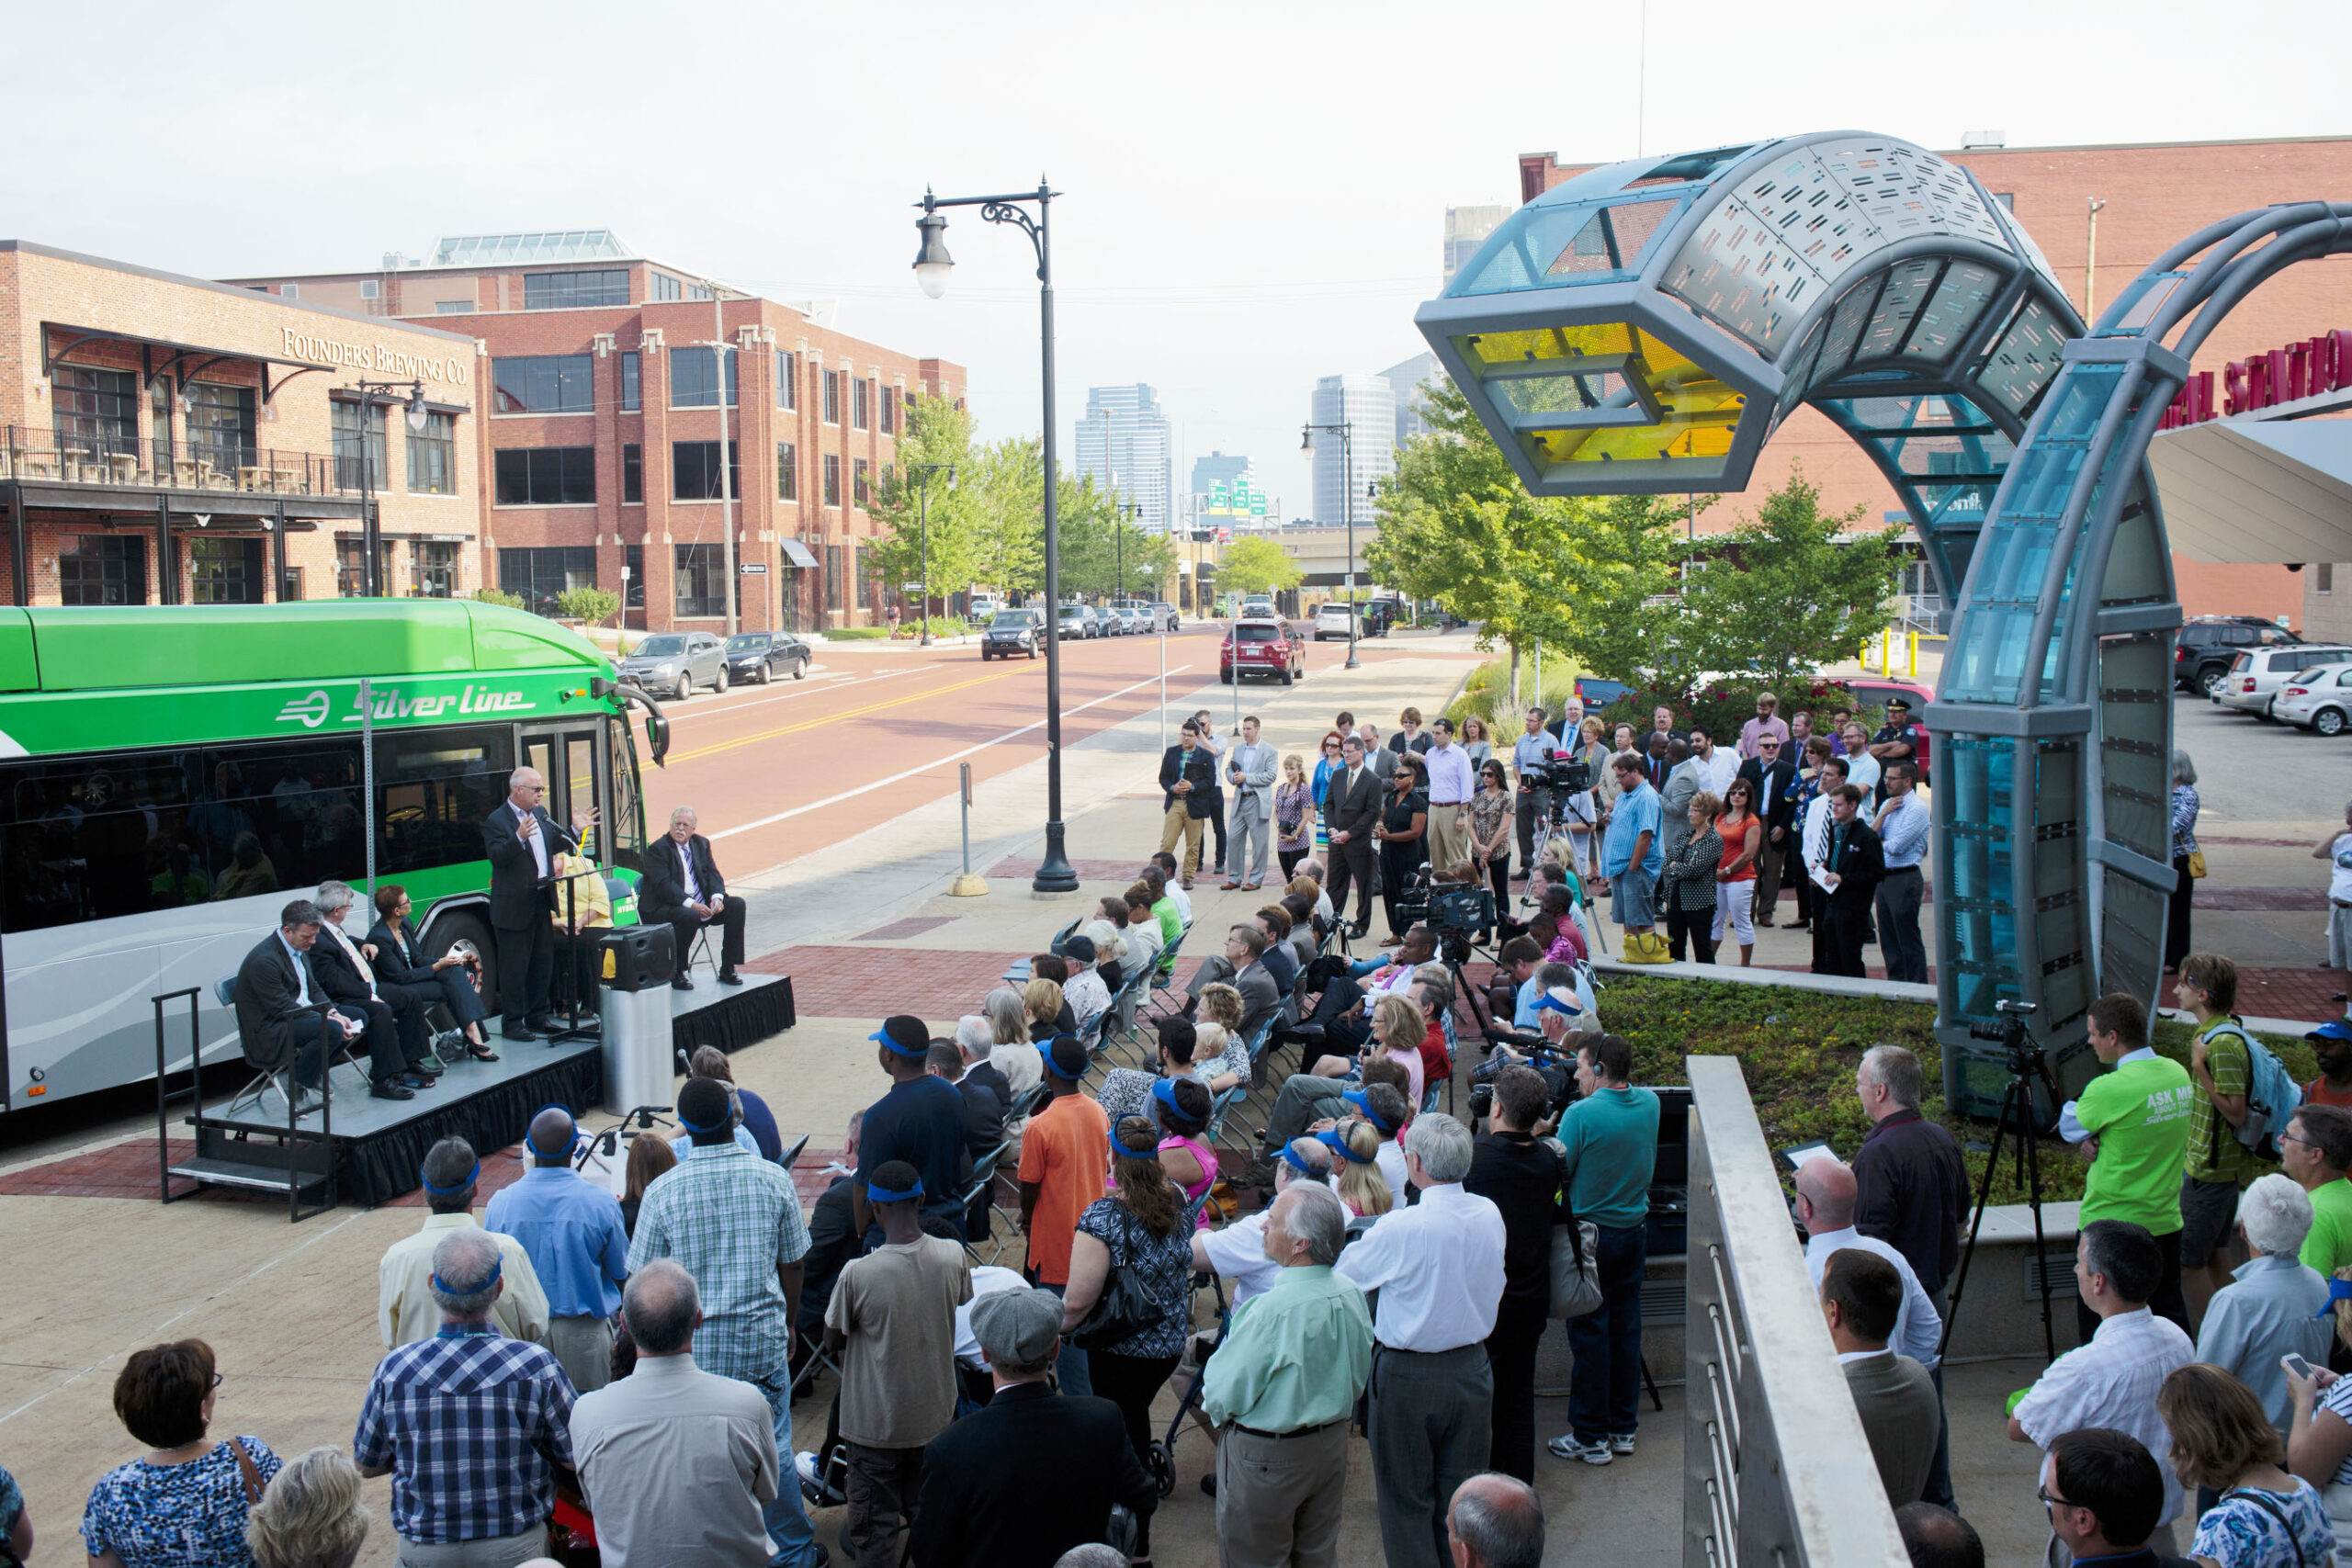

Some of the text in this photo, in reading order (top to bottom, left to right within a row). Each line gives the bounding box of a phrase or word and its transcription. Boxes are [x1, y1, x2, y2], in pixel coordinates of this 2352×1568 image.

[281, 326, 468, 386] FOUNDERS BREWING CO
[343, 689, 458, 722] Silver
[2146, 1089, 2174, 1109] ASK
